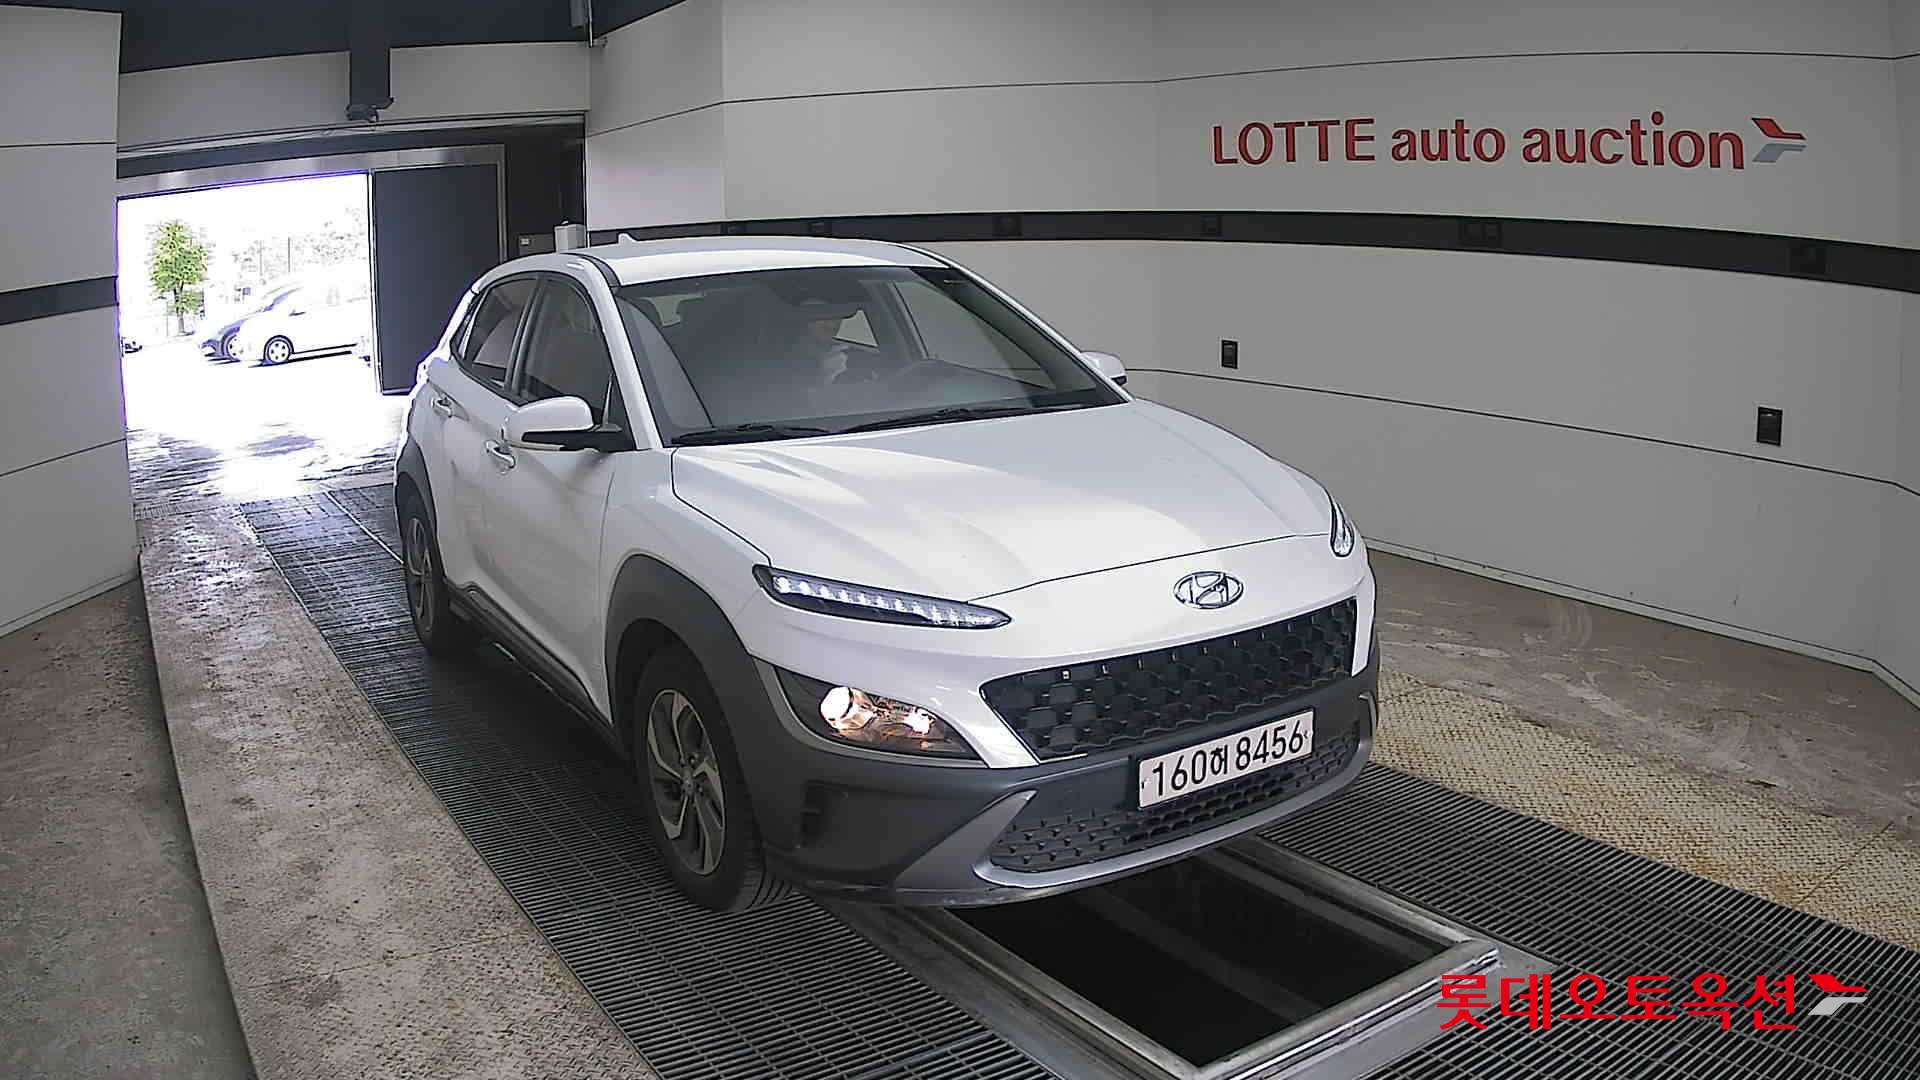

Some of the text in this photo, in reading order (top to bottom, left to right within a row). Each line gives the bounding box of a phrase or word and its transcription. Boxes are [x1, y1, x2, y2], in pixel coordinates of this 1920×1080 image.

[1213, 111, 1745, 170] LOTTE auto auction
[1152, 720, 1304, 796] 160허 8456
